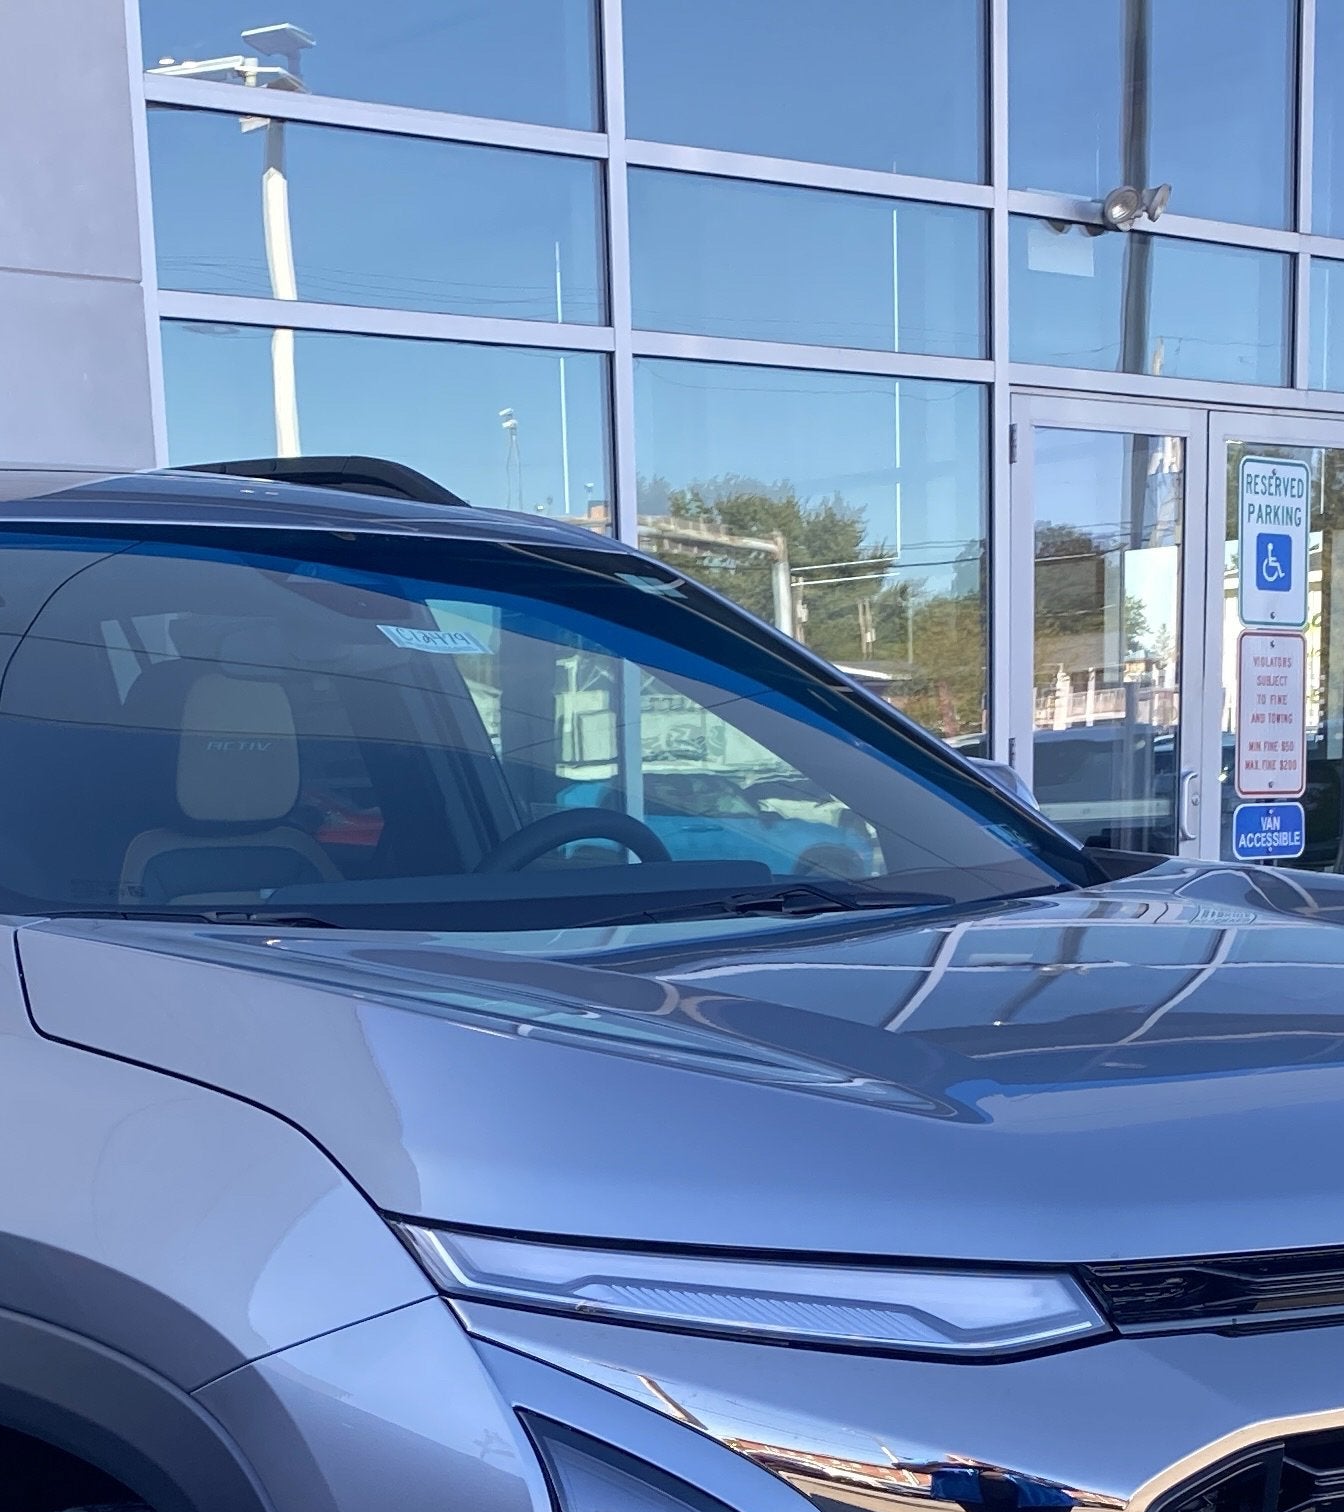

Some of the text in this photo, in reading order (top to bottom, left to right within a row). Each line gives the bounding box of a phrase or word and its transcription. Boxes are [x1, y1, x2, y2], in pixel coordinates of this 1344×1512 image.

[1245, 474, 1304, 498] RESERVED
[1247, 503, 1302, 527] PARKING
[1252, 656, 1293, 668] VIOLATORS
[1256, 675, 1288, 687] SUBJECT
[1257, 694, 1288, 705] TO FINE
[1250, 713, 1293, 724] AND TOWING
[1264, 741, 1279, 752] FINE
[1281, 741, 1295, 752] $50
[1261, 759, 1277, 770] FINE
[1279, 759, 1298, 771] $200
[1260, 816, 1281, 831] VAN
[1238, 831, 1301, 848] ACCESSIBLE
